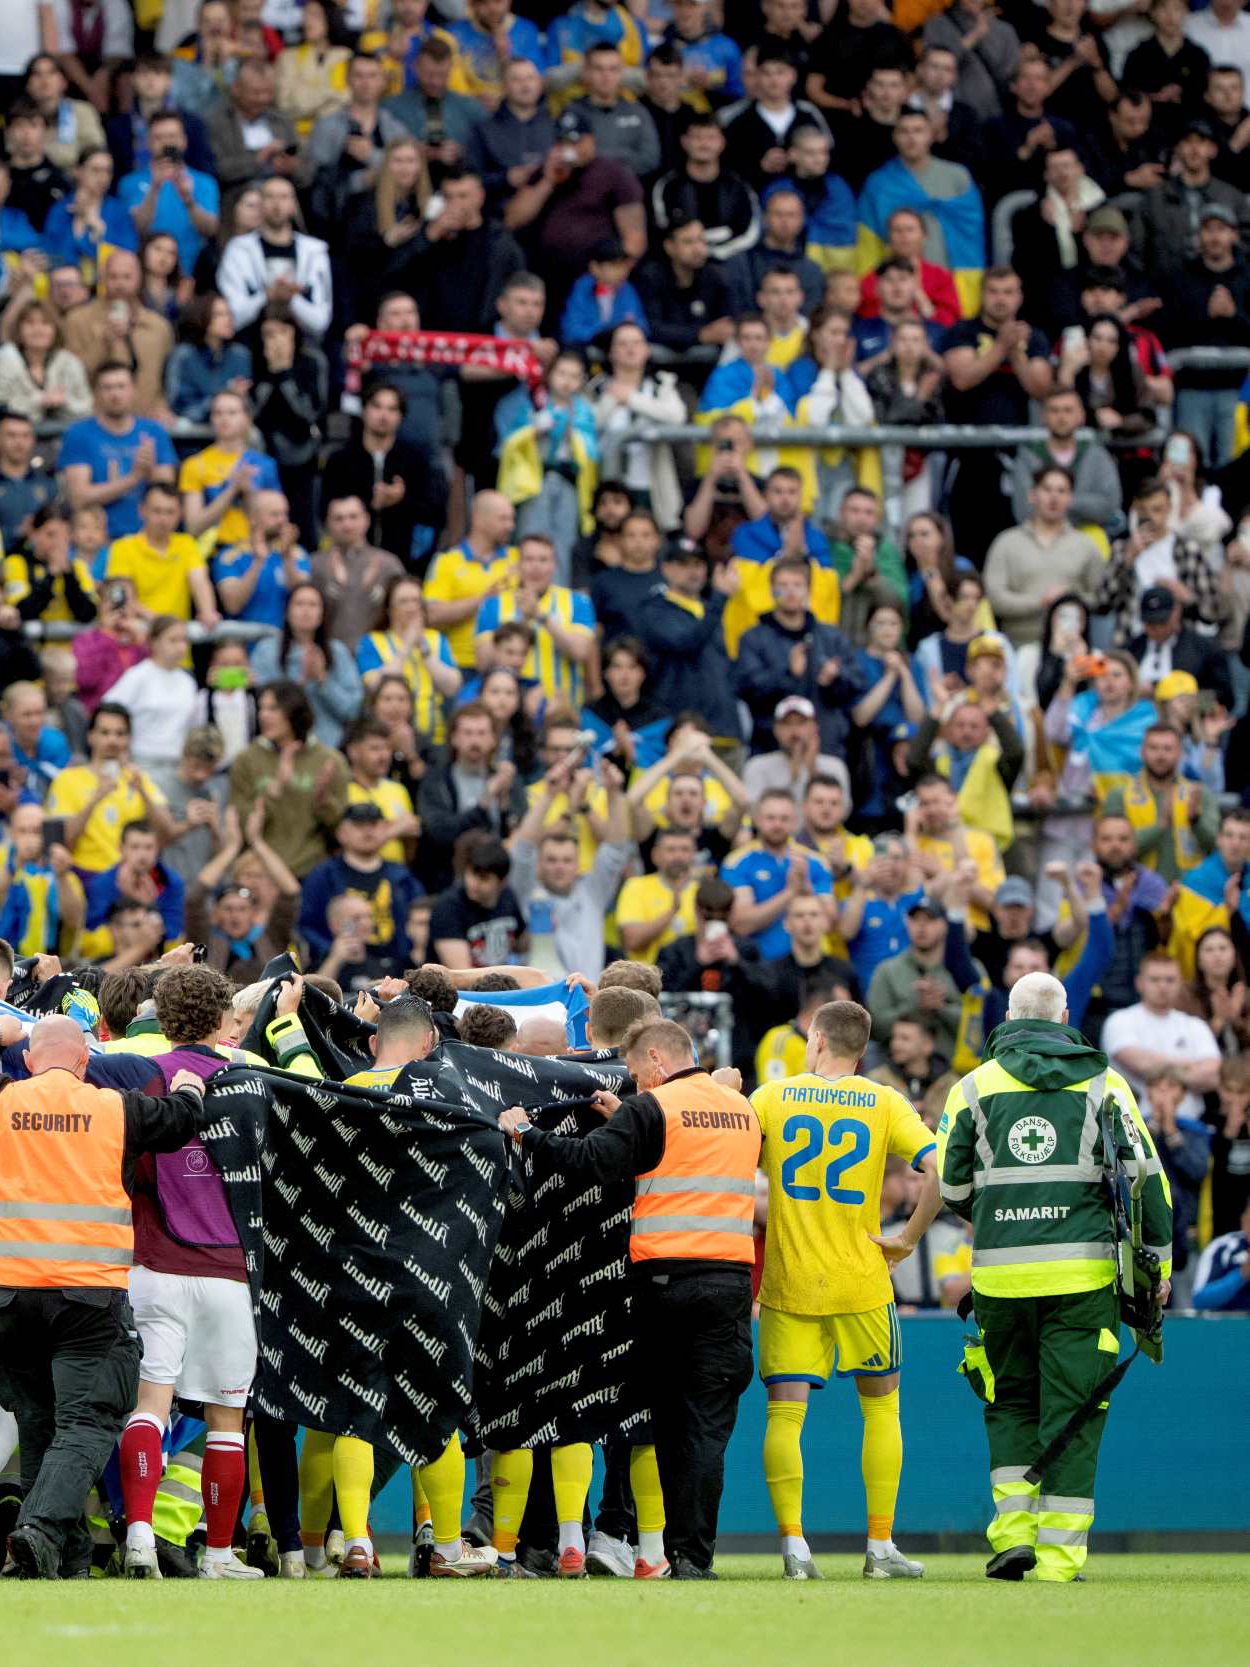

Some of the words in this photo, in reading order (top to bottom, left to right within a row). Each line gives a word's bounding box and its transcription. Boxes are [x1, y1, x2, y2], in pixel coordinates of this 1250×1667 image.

[11, 1112, 92, 1132] SECURITY
[681, 1110, 750, 1131] SECURITY
[1016, 1118, 1049, 1131] DANSK
[782, 1114, 870, 1205] 22
[1011, 1137, 1054, 1161] FOLKEHJÆLP
[563, 1185, 602, 1221] Albani
[994, 1206, 1070, 1221] SAMARIT
[545, 1237, 584, 1278] Albani
[580, 1254, 627, 1294] Albani
[526, 1293, 564, 1335] Albani
[562, 1311, 606, 1350] Albani
[505, 1350, 546, 1389] Albani
[601, 1340, 633, 1367] ani
[536, 1365, 583, 1402] Albani
[572, 1383, 624, 1417] Albani
[620, 1409, 651, 1437] lbani
